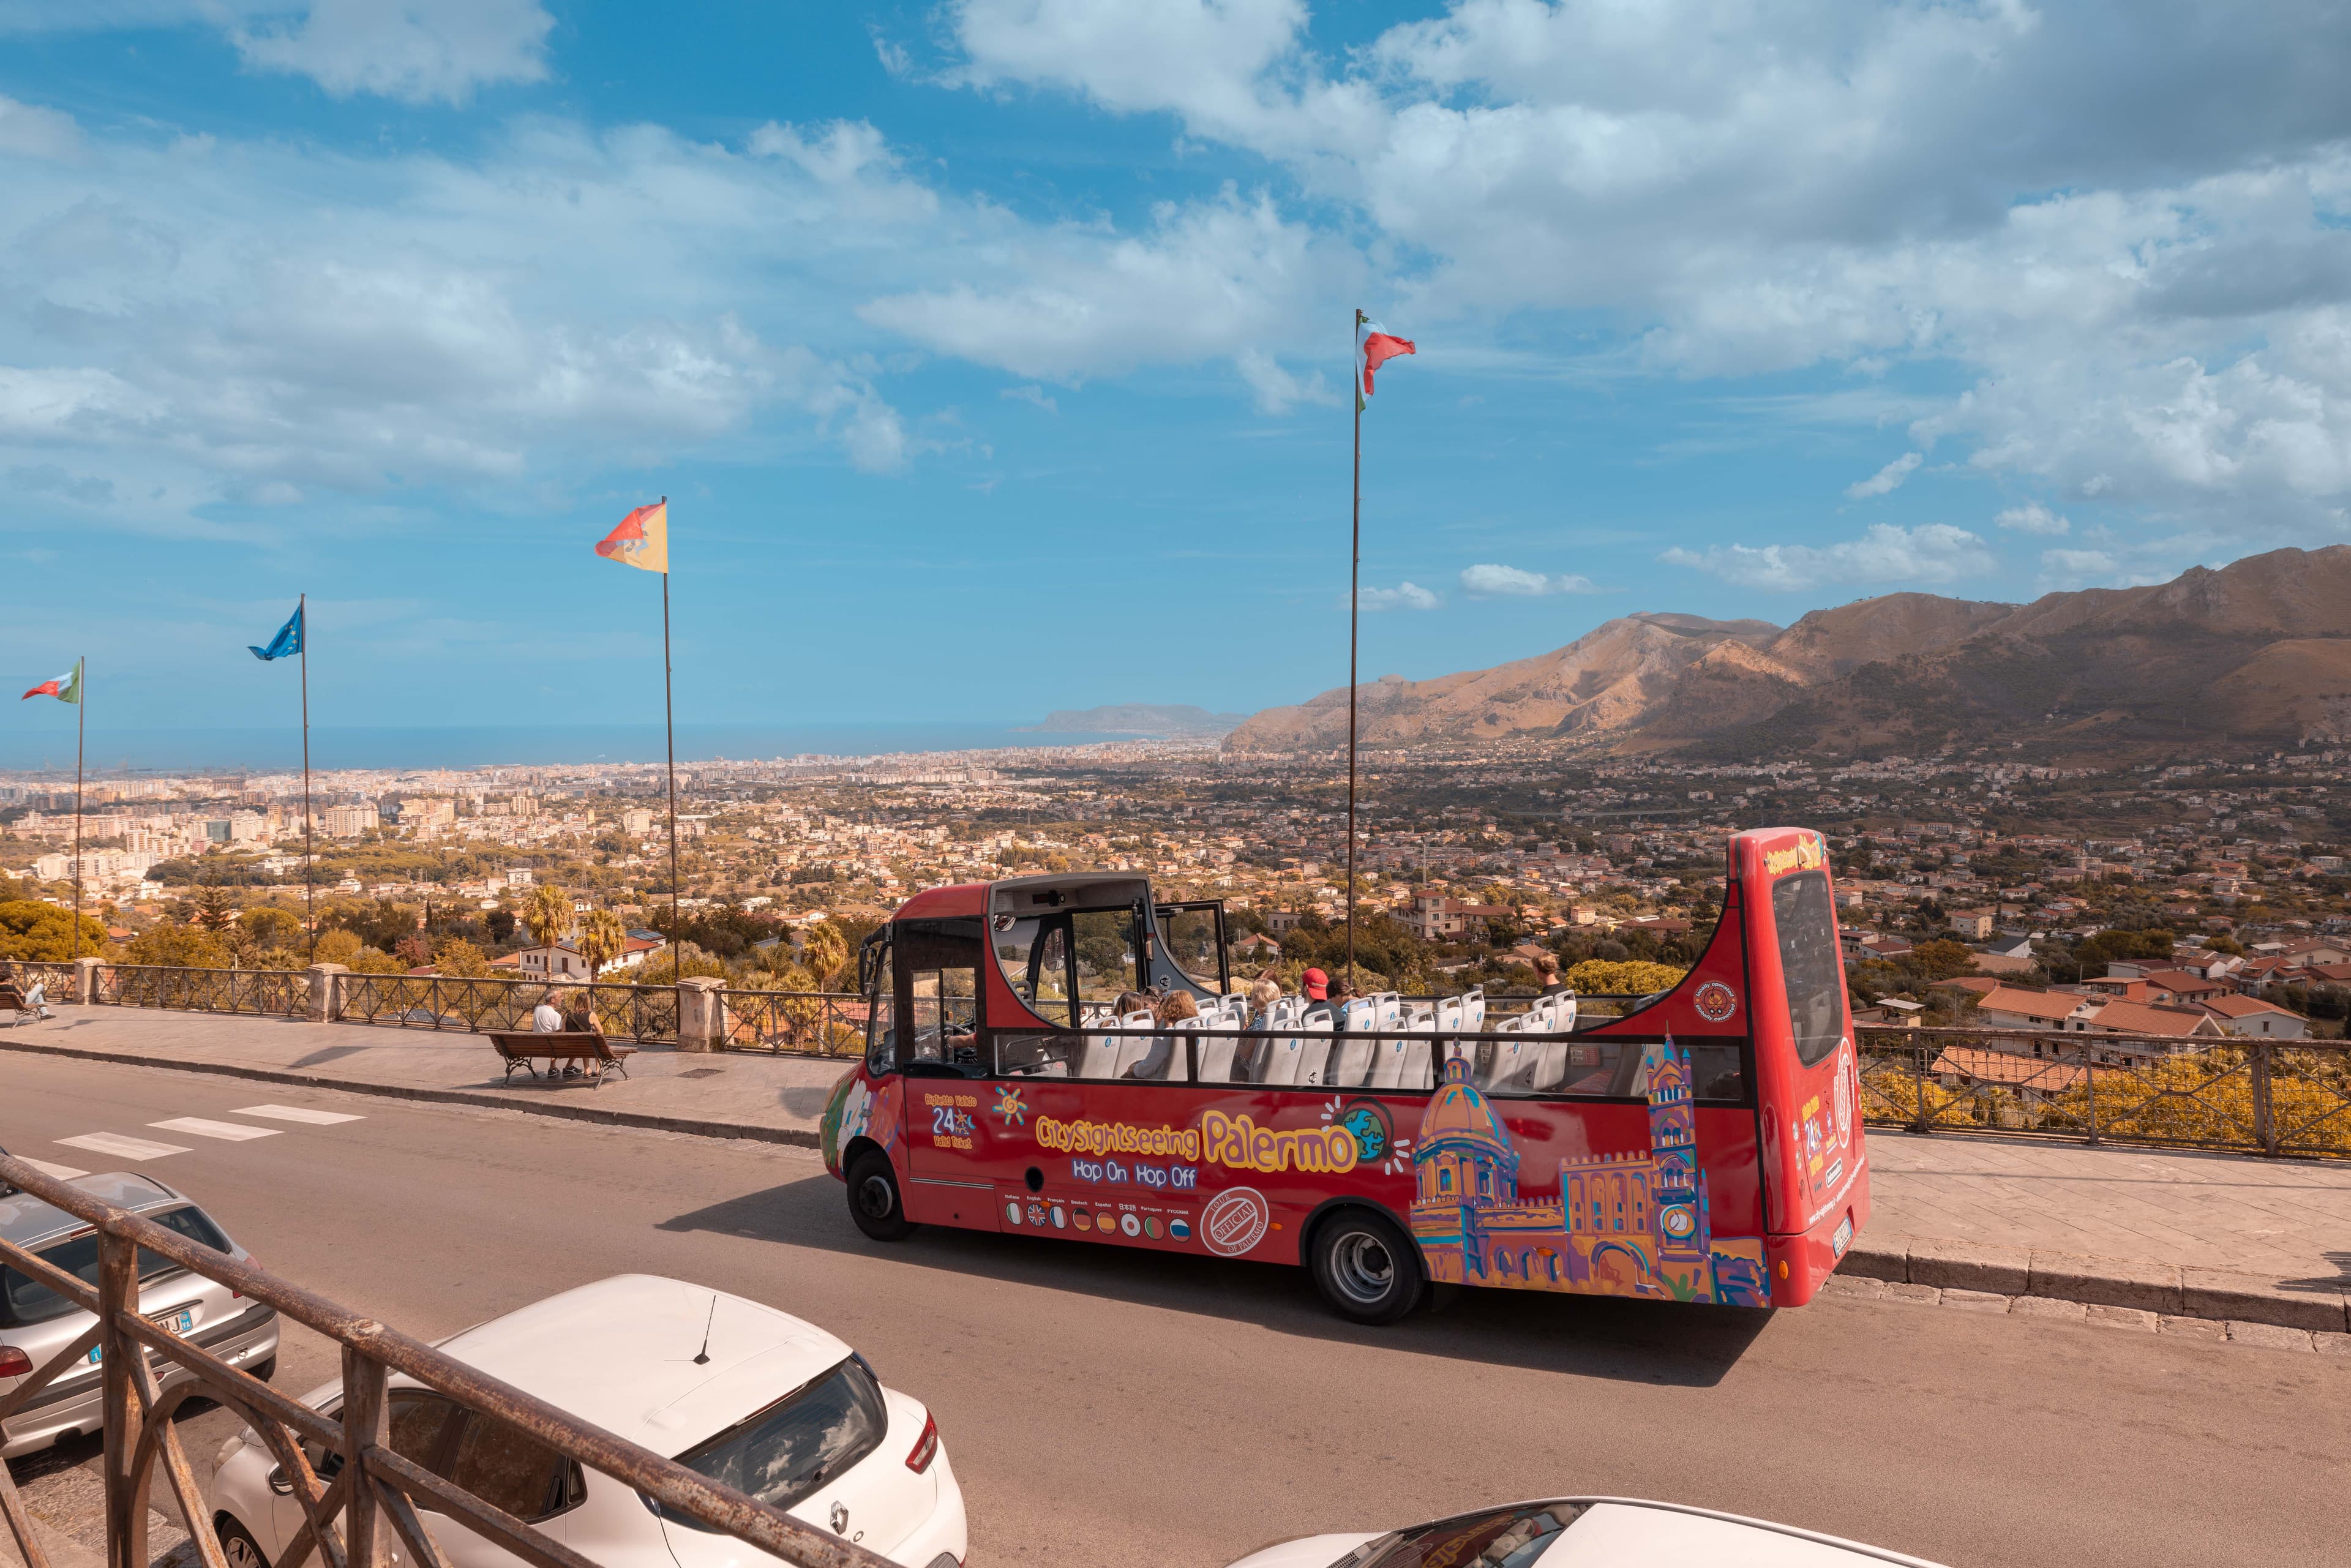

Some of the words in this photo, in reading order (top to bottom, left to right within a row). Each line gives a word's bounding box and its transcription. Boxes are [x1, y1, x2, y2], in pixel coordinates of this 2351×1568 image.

[1695, 983, 1710, 997] locally
[1712, 982, 1734, 997] operated
[1695, 1004, 1713, 1021] globally
[1714, 1003, 1735, 1021] connected
[925, 1093, 954, 1106] Biglietto
[955, 1095, 977, 1107] Valido
[932, 1106, 955, 1135] 24
[934, 1135, 951, 1147] Valid
[951, 1136, 972, 1149] Ticket
[1036, 1116, 1199, 1161] CitySightseeing
[1202, 1110, 1358, 1173] Palermo
[1073, 1160, 1103, 1183] Hop
[1106, 1161, 1128, 1182] On
[1136, 1165, 1166, 1188] Hop
[1171, 1166, 1196, 1187] Off
[1210, 1194, 1231, 1212] TOUR
[1215, 1204, 1254, 1239] OFFICIAL
[1239, 1221, 1264, 1250] PALERMO
